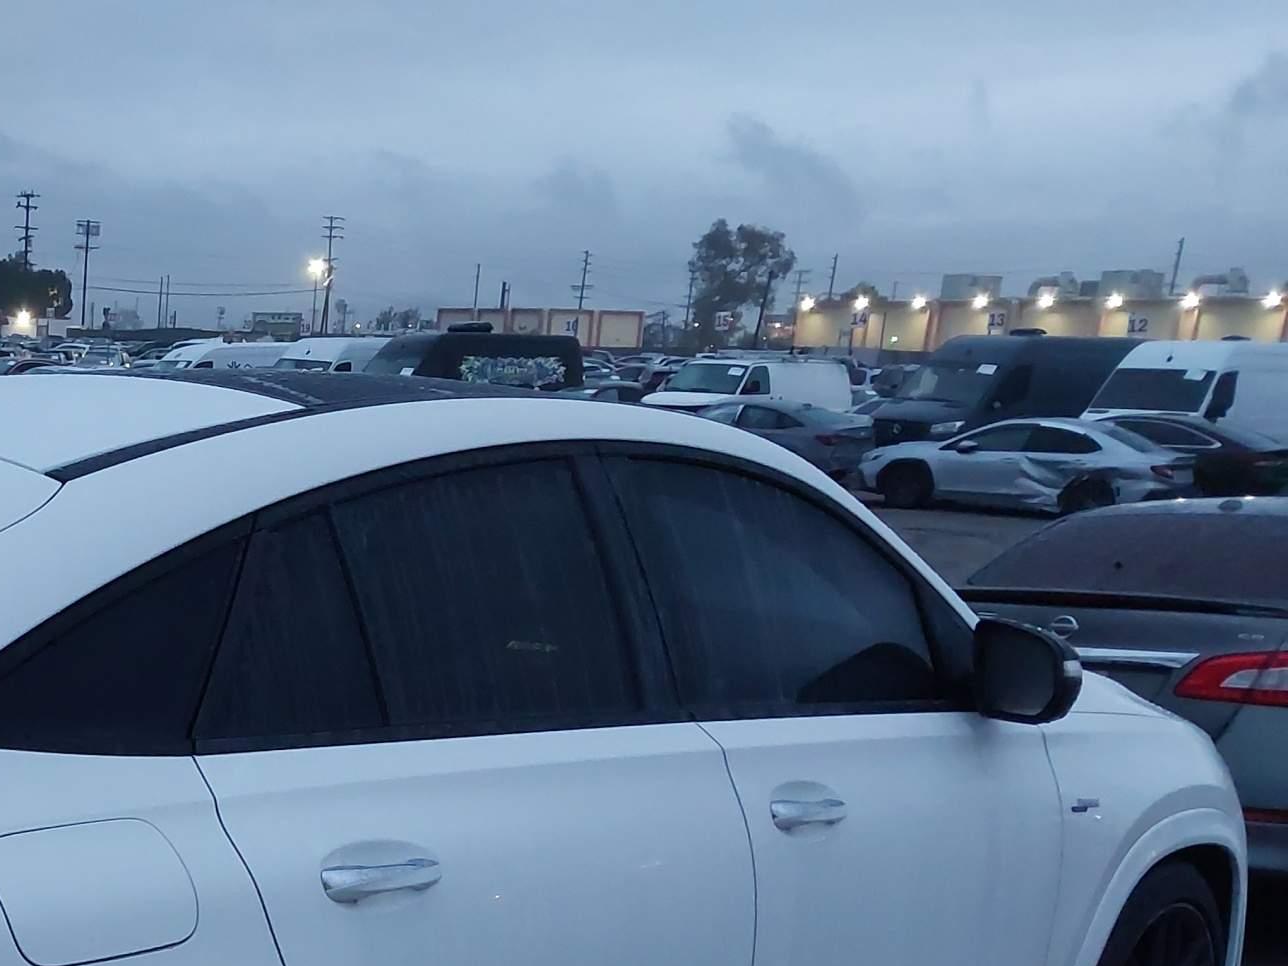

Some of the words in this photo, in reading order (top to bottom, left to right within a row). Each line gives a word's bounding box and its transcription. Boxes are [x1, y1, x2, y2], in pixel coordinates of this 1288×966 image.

[850, 312, 867, 325] 14
[988, 313, 1005, 327] 13
[1128, 318, 1148, 333] 12
